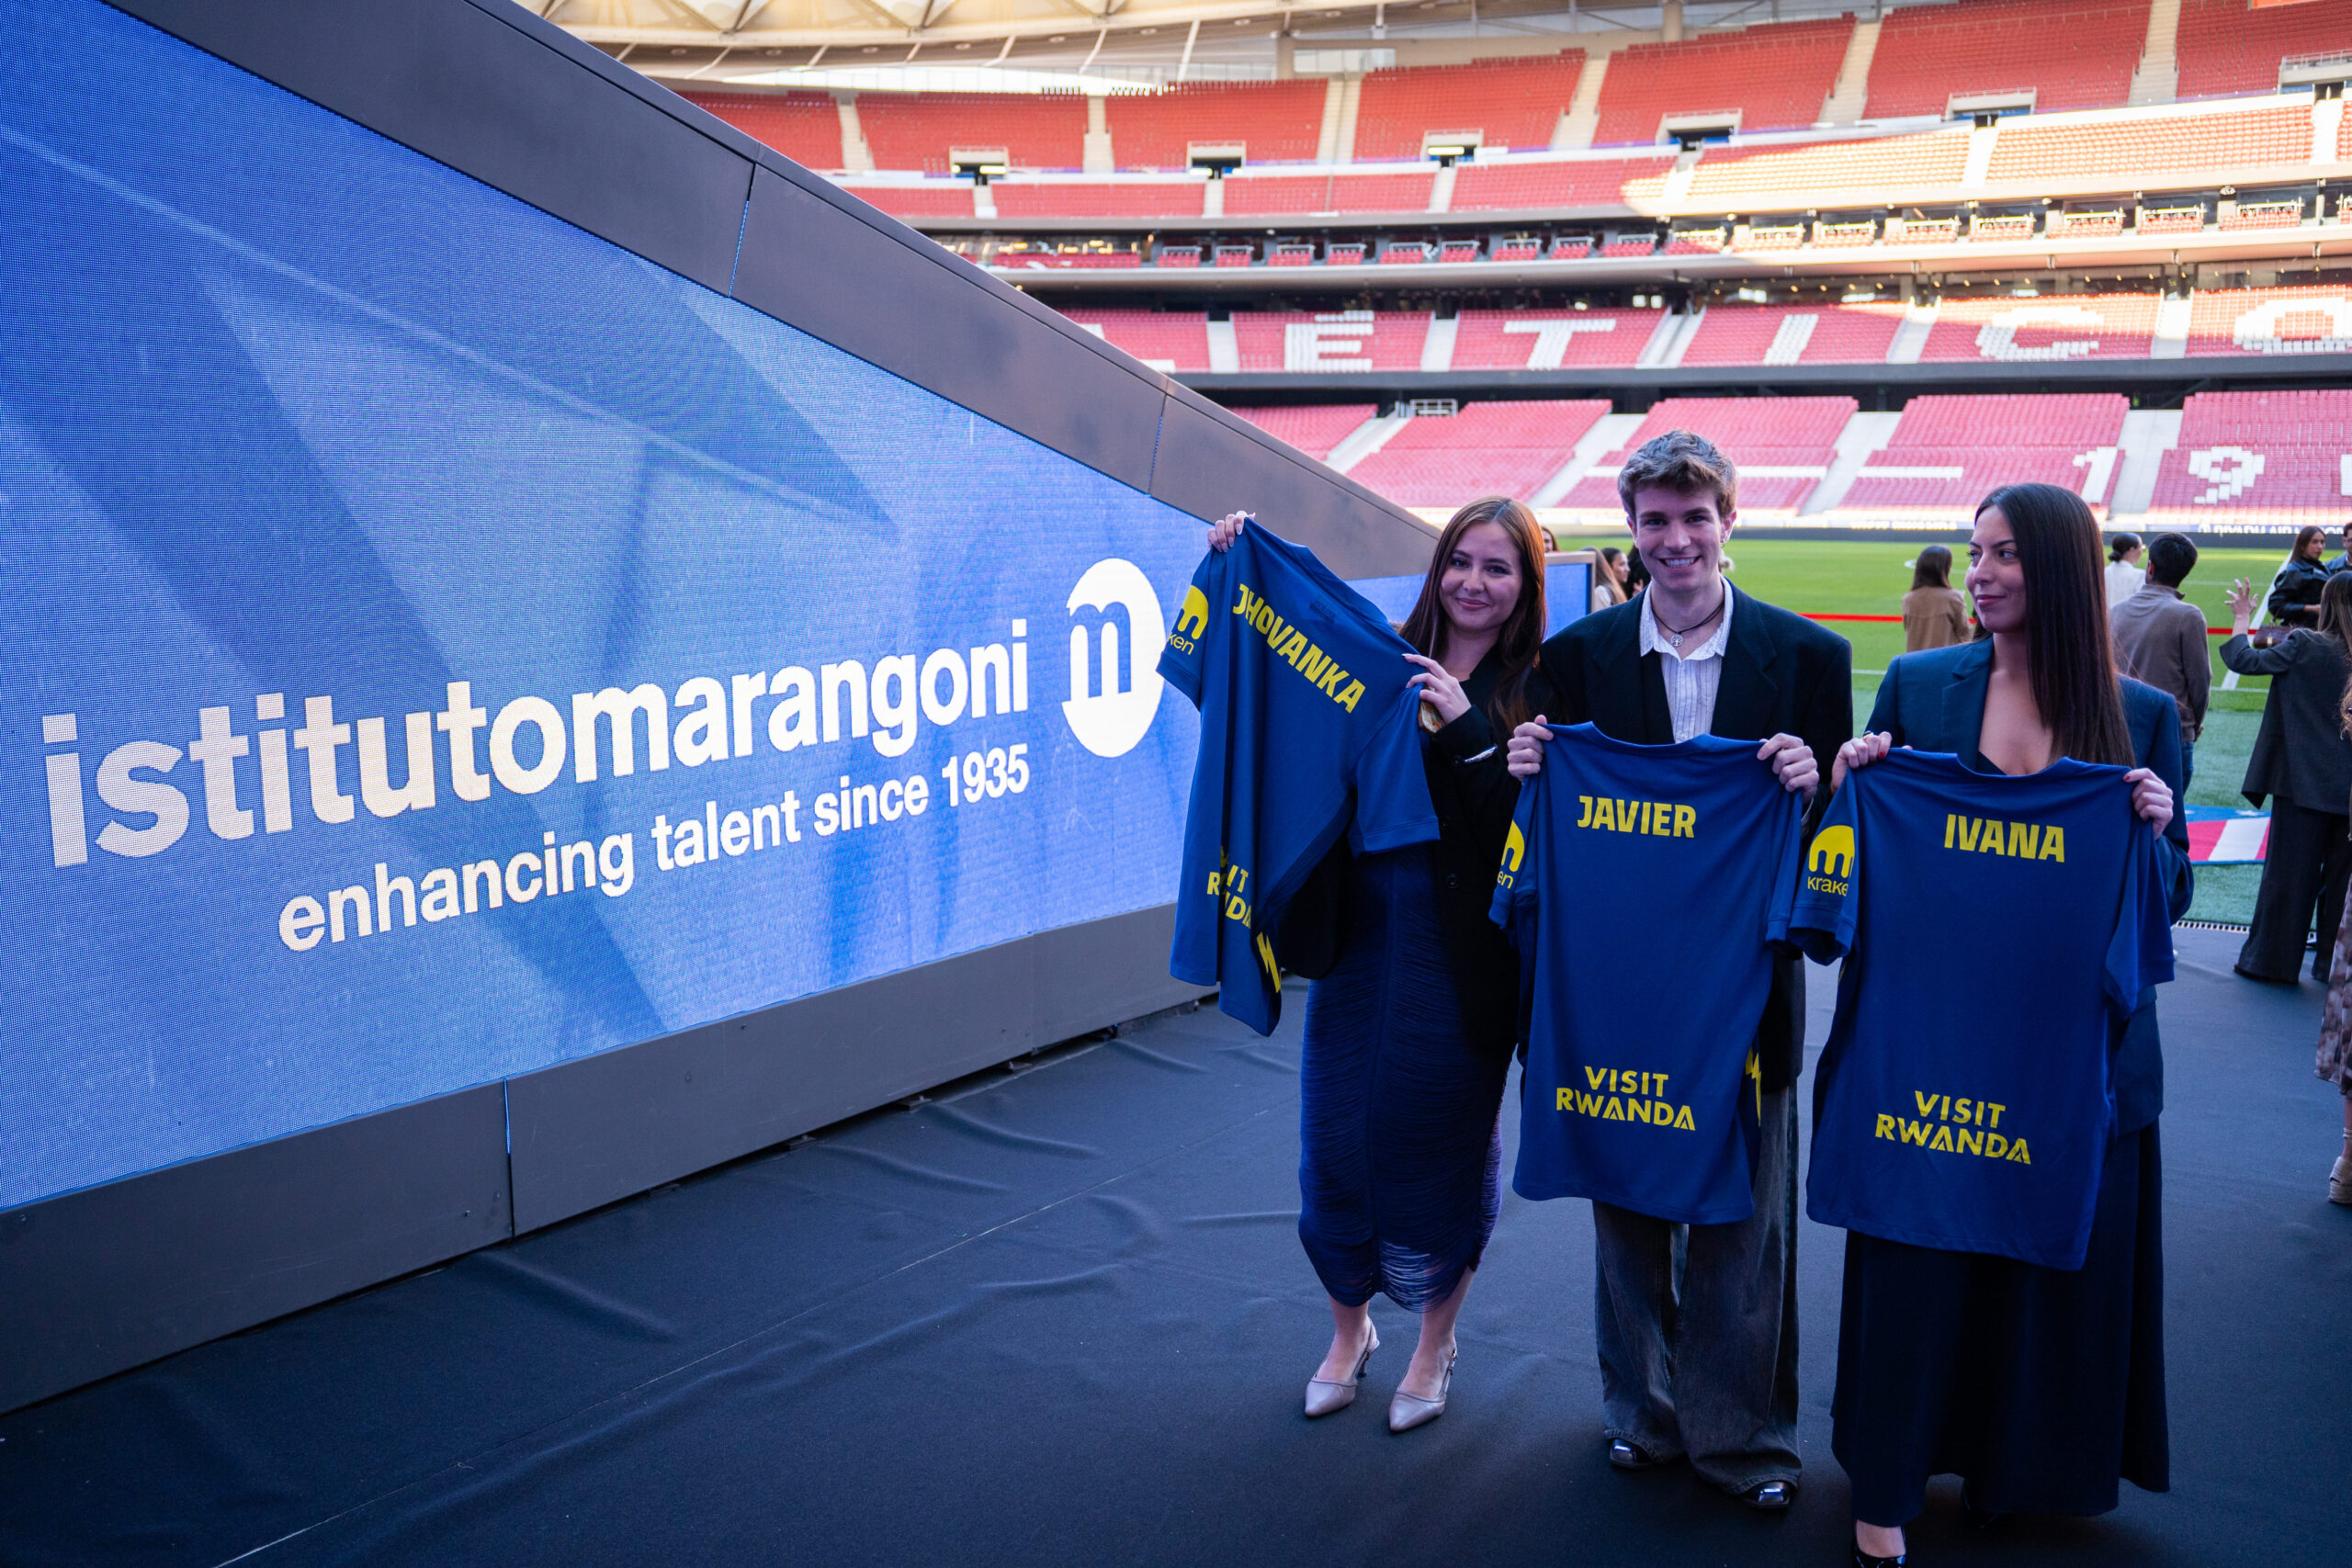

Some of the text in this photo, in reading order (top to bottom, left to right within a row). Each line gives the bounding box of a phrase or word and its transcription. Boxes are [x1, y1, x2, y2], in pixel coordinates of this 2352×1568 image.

[2073, 446, 2352, 506] 19
[1232, 583, 1366, 714] JHOVANKA
[42, 618, 1028, 867] istitutomarangoni
[1577, 795, 1697, 839] JAVIER
[1944, 814, 2065, 863] IVANA
[278, 743, 1030, 952] enhancing talent since 1935
[1807, 875, 1849, 897] krake
[1584, 1066, 1669, 1098] VISIT
[1555, 1088, 1696, 1132] RWANDA
[1914, 1090, 2007, 1129] VISIT
[1874, 1113, 2032, 1165] RWANDA
